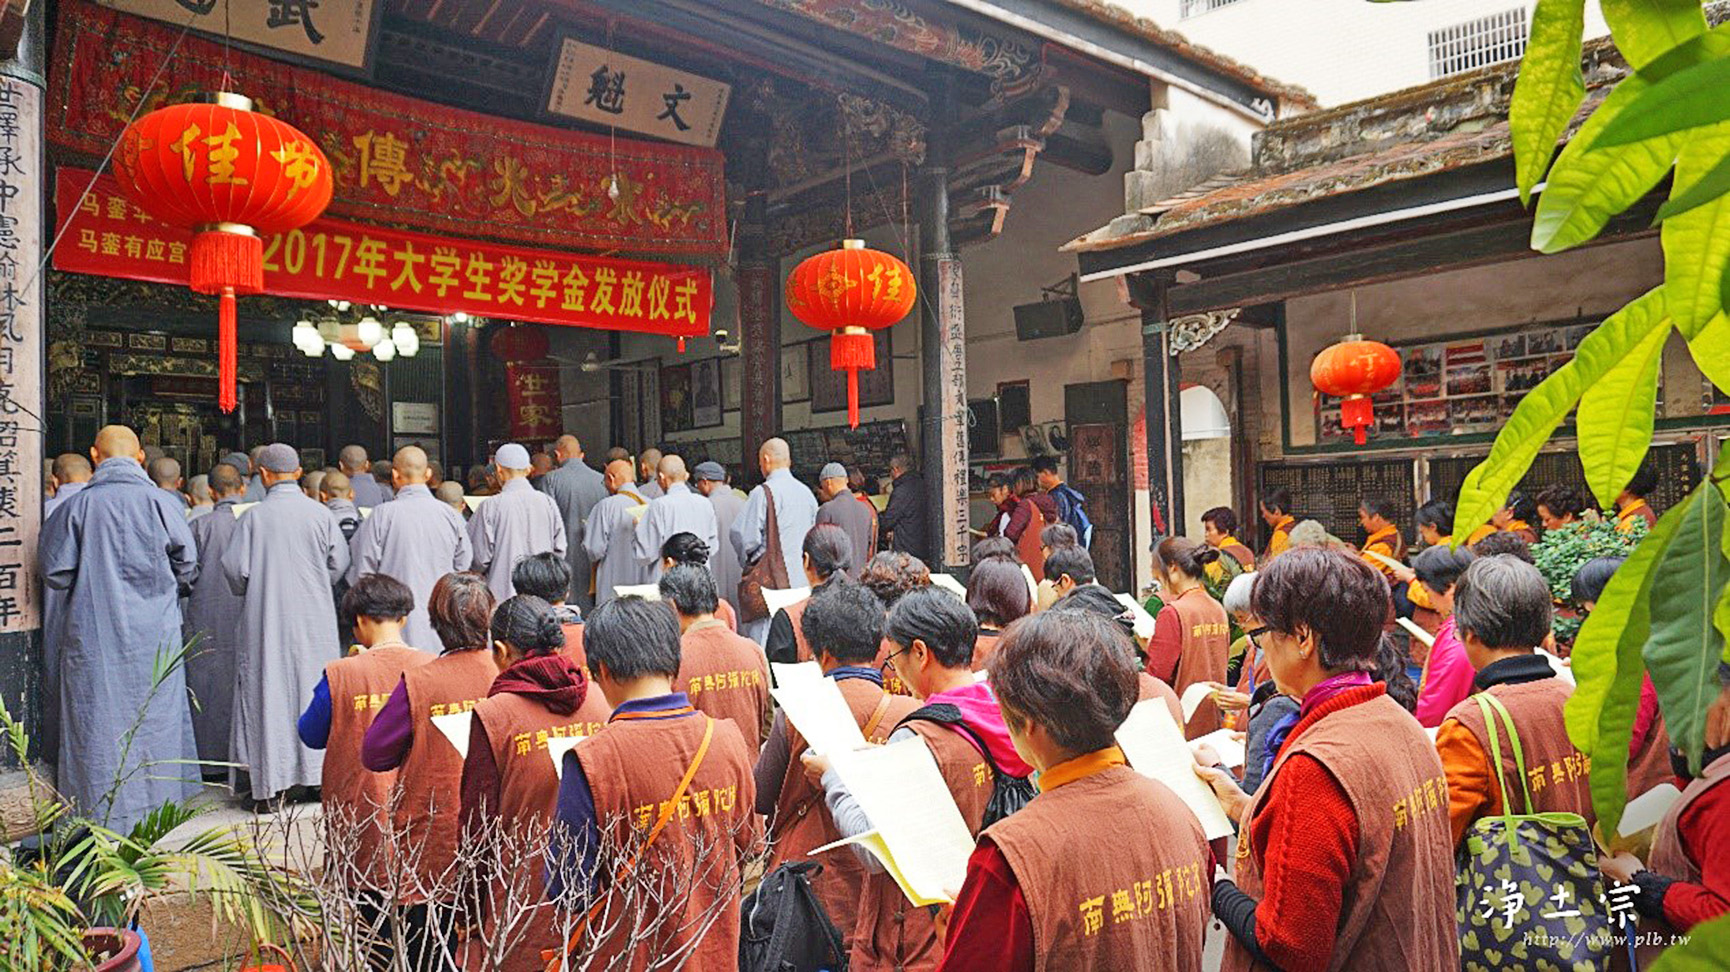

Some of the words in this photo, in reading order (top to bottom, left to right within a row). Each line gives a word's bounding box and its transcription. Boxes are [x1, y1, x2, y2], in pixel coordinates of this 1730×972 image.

[353, 130, 414, 196] 傳
[78, 228, 187, 264] 马銮有应宫
[263, 228, 698, 325] 2017年大学生奖学金发放仪式
